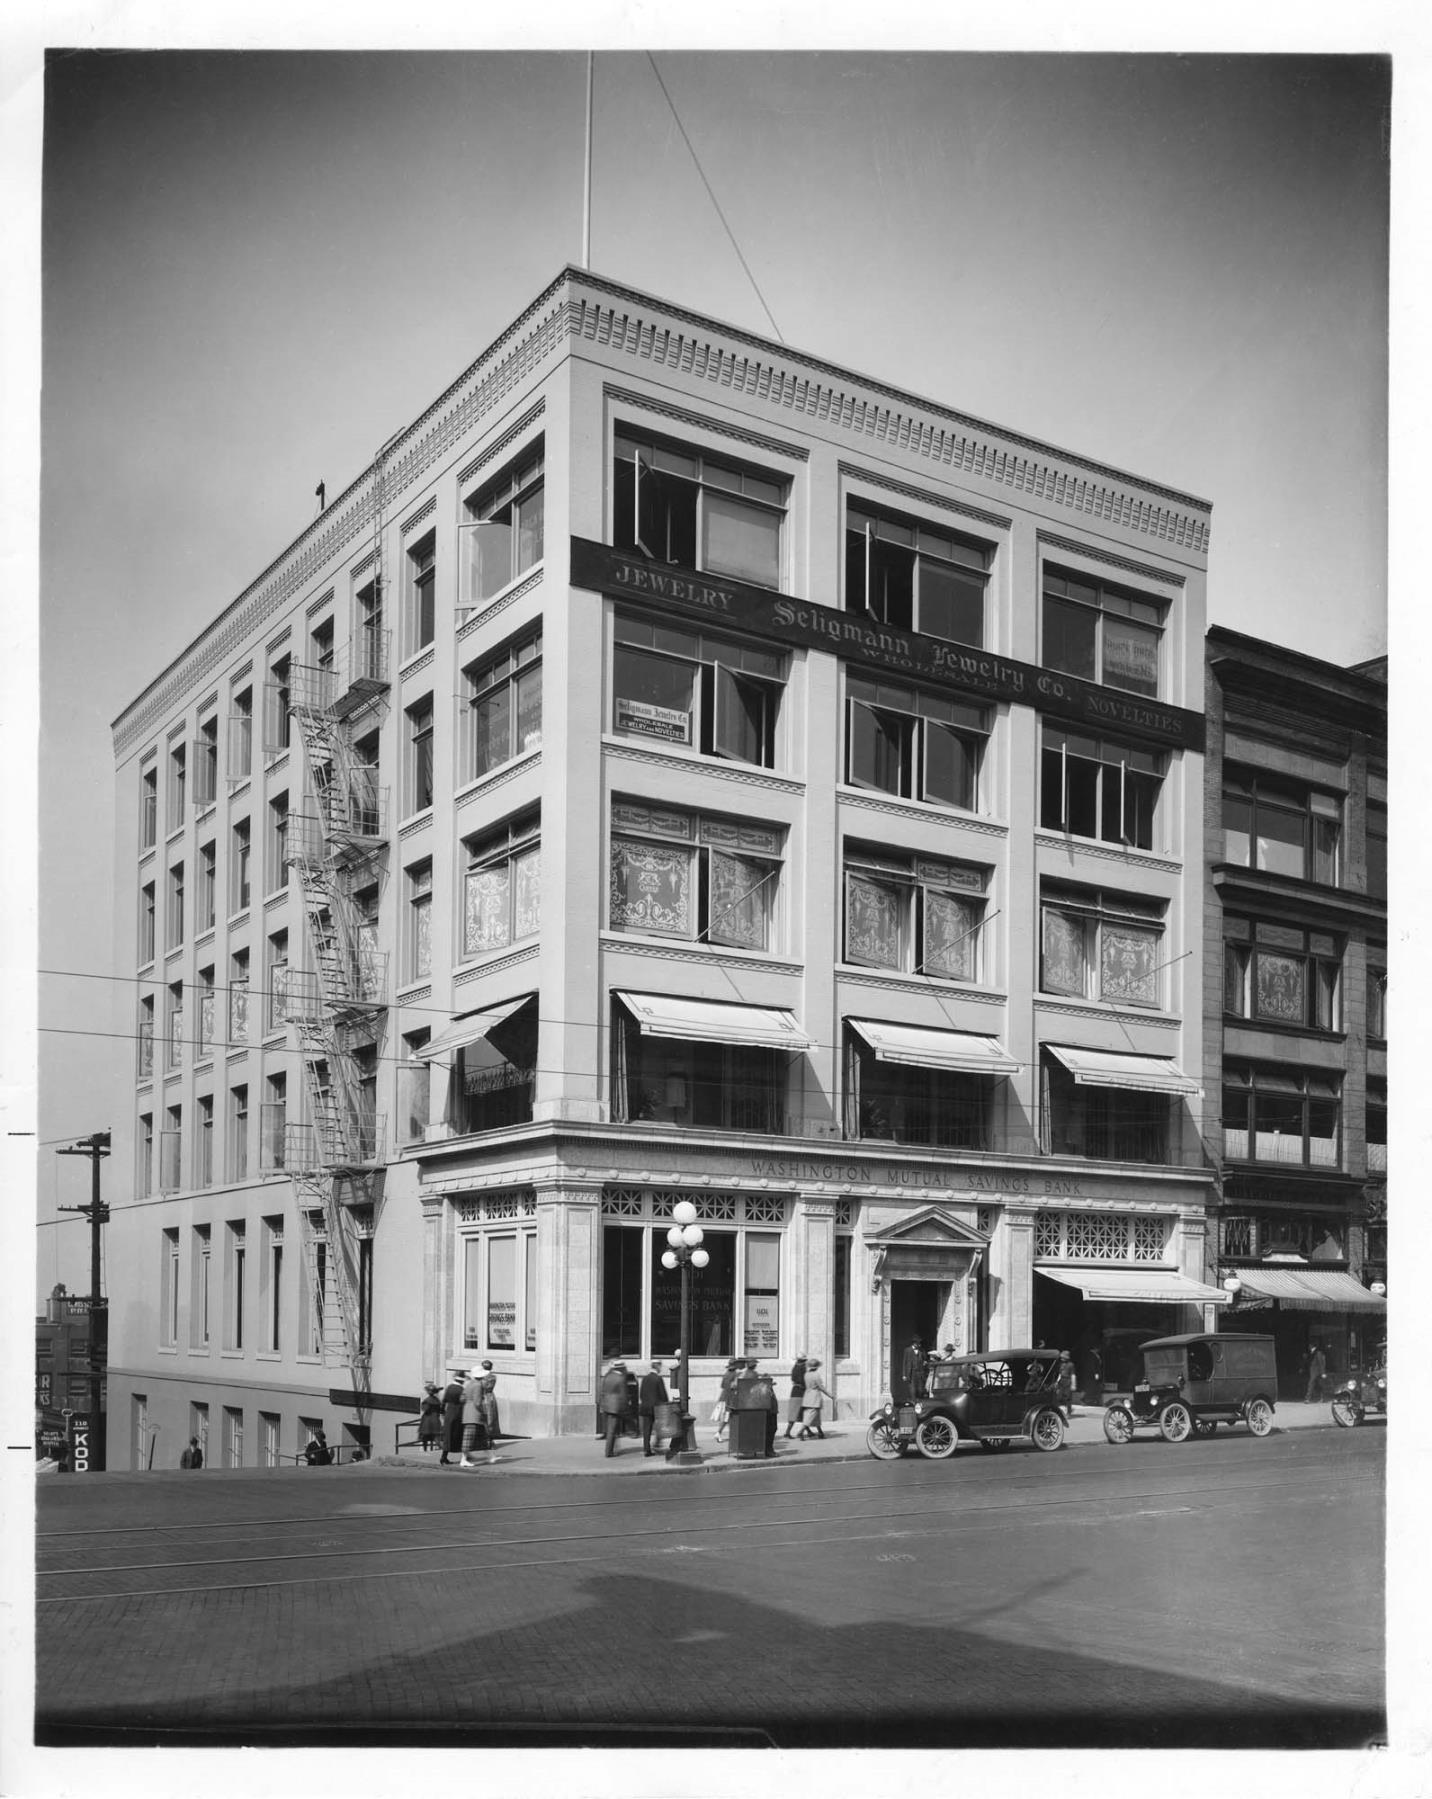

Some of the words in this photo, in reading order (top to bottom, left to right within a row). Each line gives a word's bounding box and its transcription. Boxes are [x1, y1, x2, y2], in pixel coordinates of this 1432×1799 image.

[615, 565, 734, 611] JEWELRY
[772, 600, 910, 655] Seligmann
[931, 643, 1025, 693] Jewelry
[1036, 676, 1073, 702] Co.
[1086, 695, 1184, 733] NOVELTIES
[752, 1159, 871, 1181] WASHINGTON
[887, 1169, 950, 1187] MUTUAL
[967, 1174, 1030, 1192] SAVINGS
[1044, 1179, 1082, 1195] BANK
[74, 1433, 88, 1472] KOD
